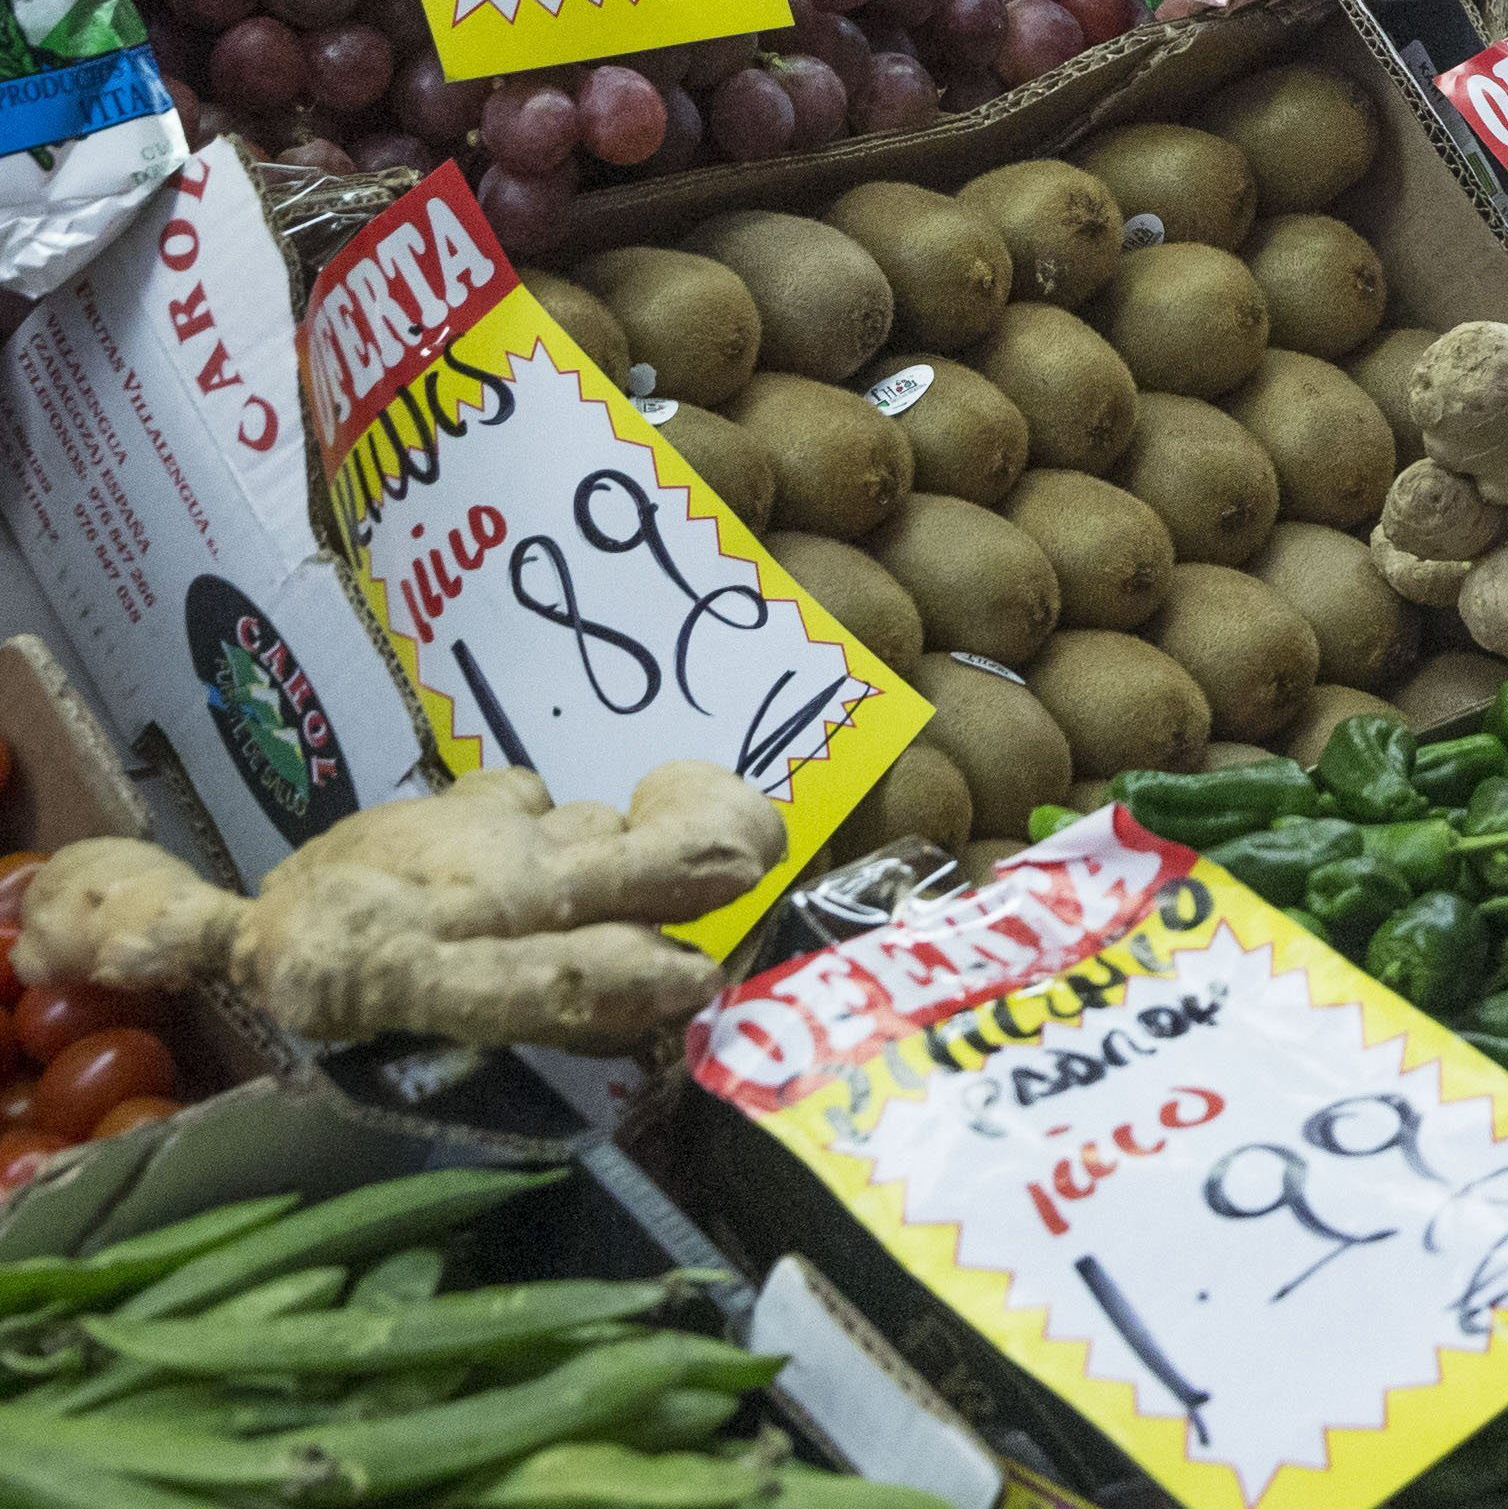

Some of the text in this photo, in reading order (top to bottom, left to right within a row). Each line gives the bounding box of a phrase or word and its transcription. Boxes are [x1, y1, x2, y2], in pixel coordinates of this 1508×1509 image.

[44, 312, 130, 467] VILLALENGUA
[310, 197, 496, 447] OFERTA
[76, 284, 126, 374] FRUTAS
[119, 369, 213, 535] VILLALENGUA
[72, 502, 99, 543] 976
[85, 485, 113, 526] 976
[98, 467, 154, 555] ESPAÑA
[237, 616, 337, 787] CAROL
[714, 832, 1159, 1086] OFERTA
